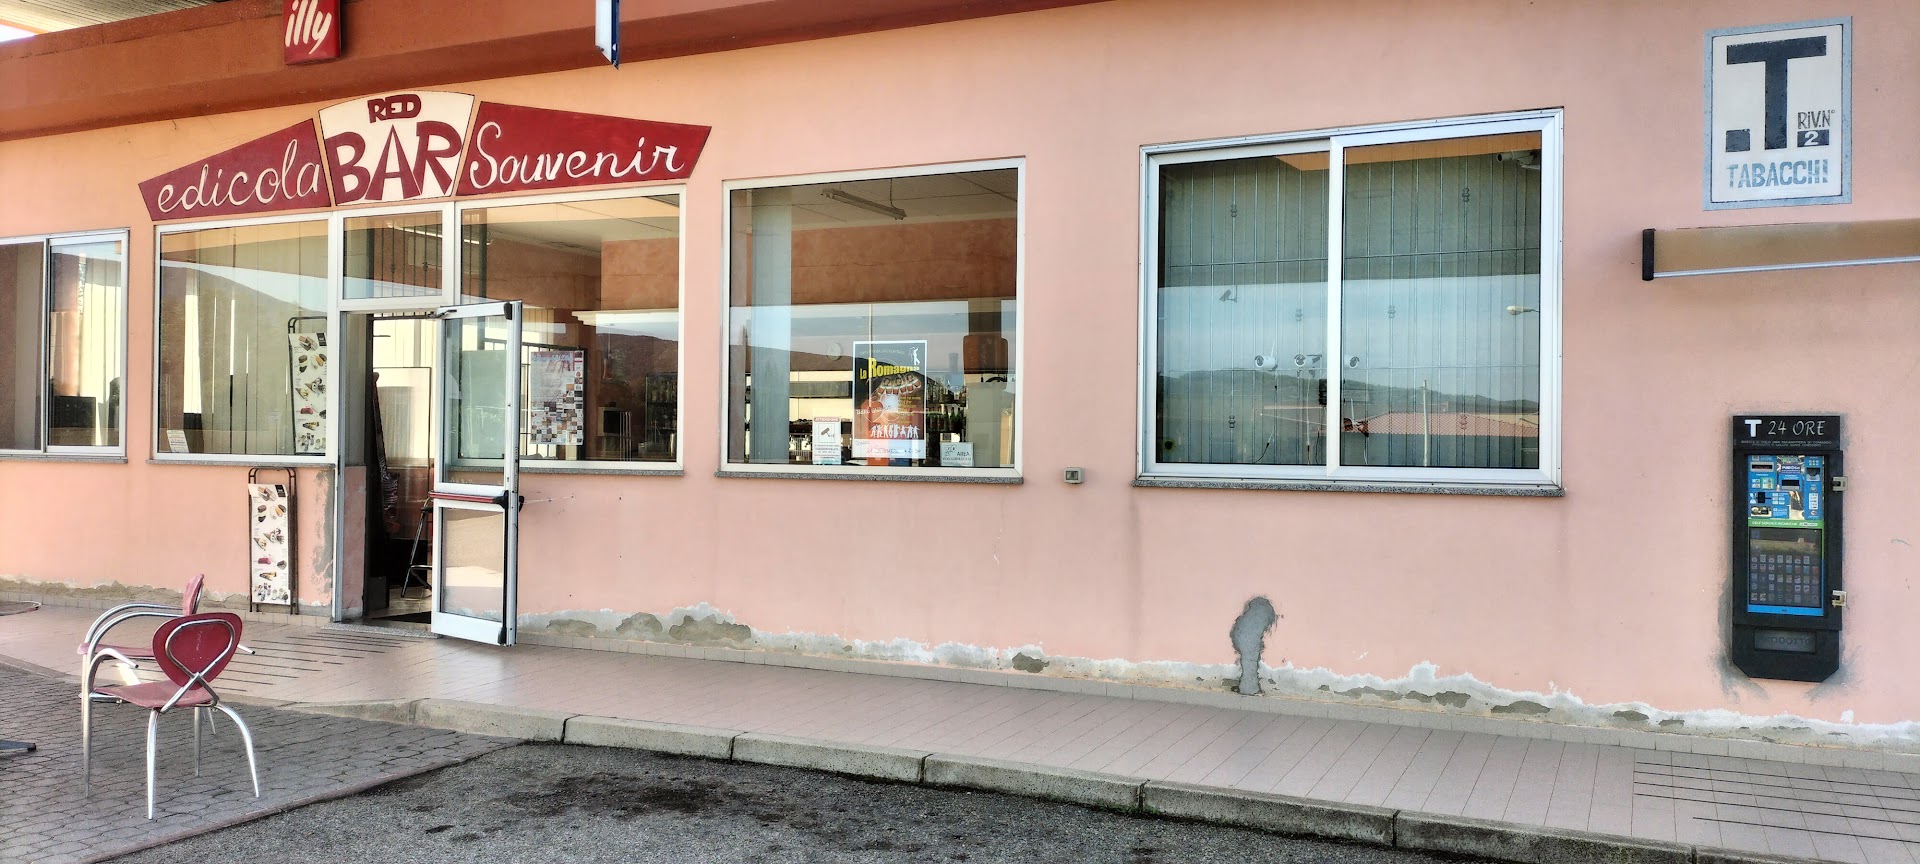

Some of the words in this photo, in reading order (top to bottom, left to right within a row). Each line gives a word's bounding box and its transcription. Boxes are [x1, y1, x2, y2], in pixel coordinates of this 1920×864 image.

[284, 0, 333, 55] illy
[367, 94, 422, 124] RED
[469, 121, 685, 190] Souvenir
[1803, 130, 1819, 146] 2
[158, 138, 320, 213] edicola
[324, 119, 462, 203] BAR
[1726, 158, 1829, 189] TABACCHI
[1744, 419, 1763, 438] T
[1768, 420, 1787, 436] 24
[1792, 420, 1826, 437] ORE
